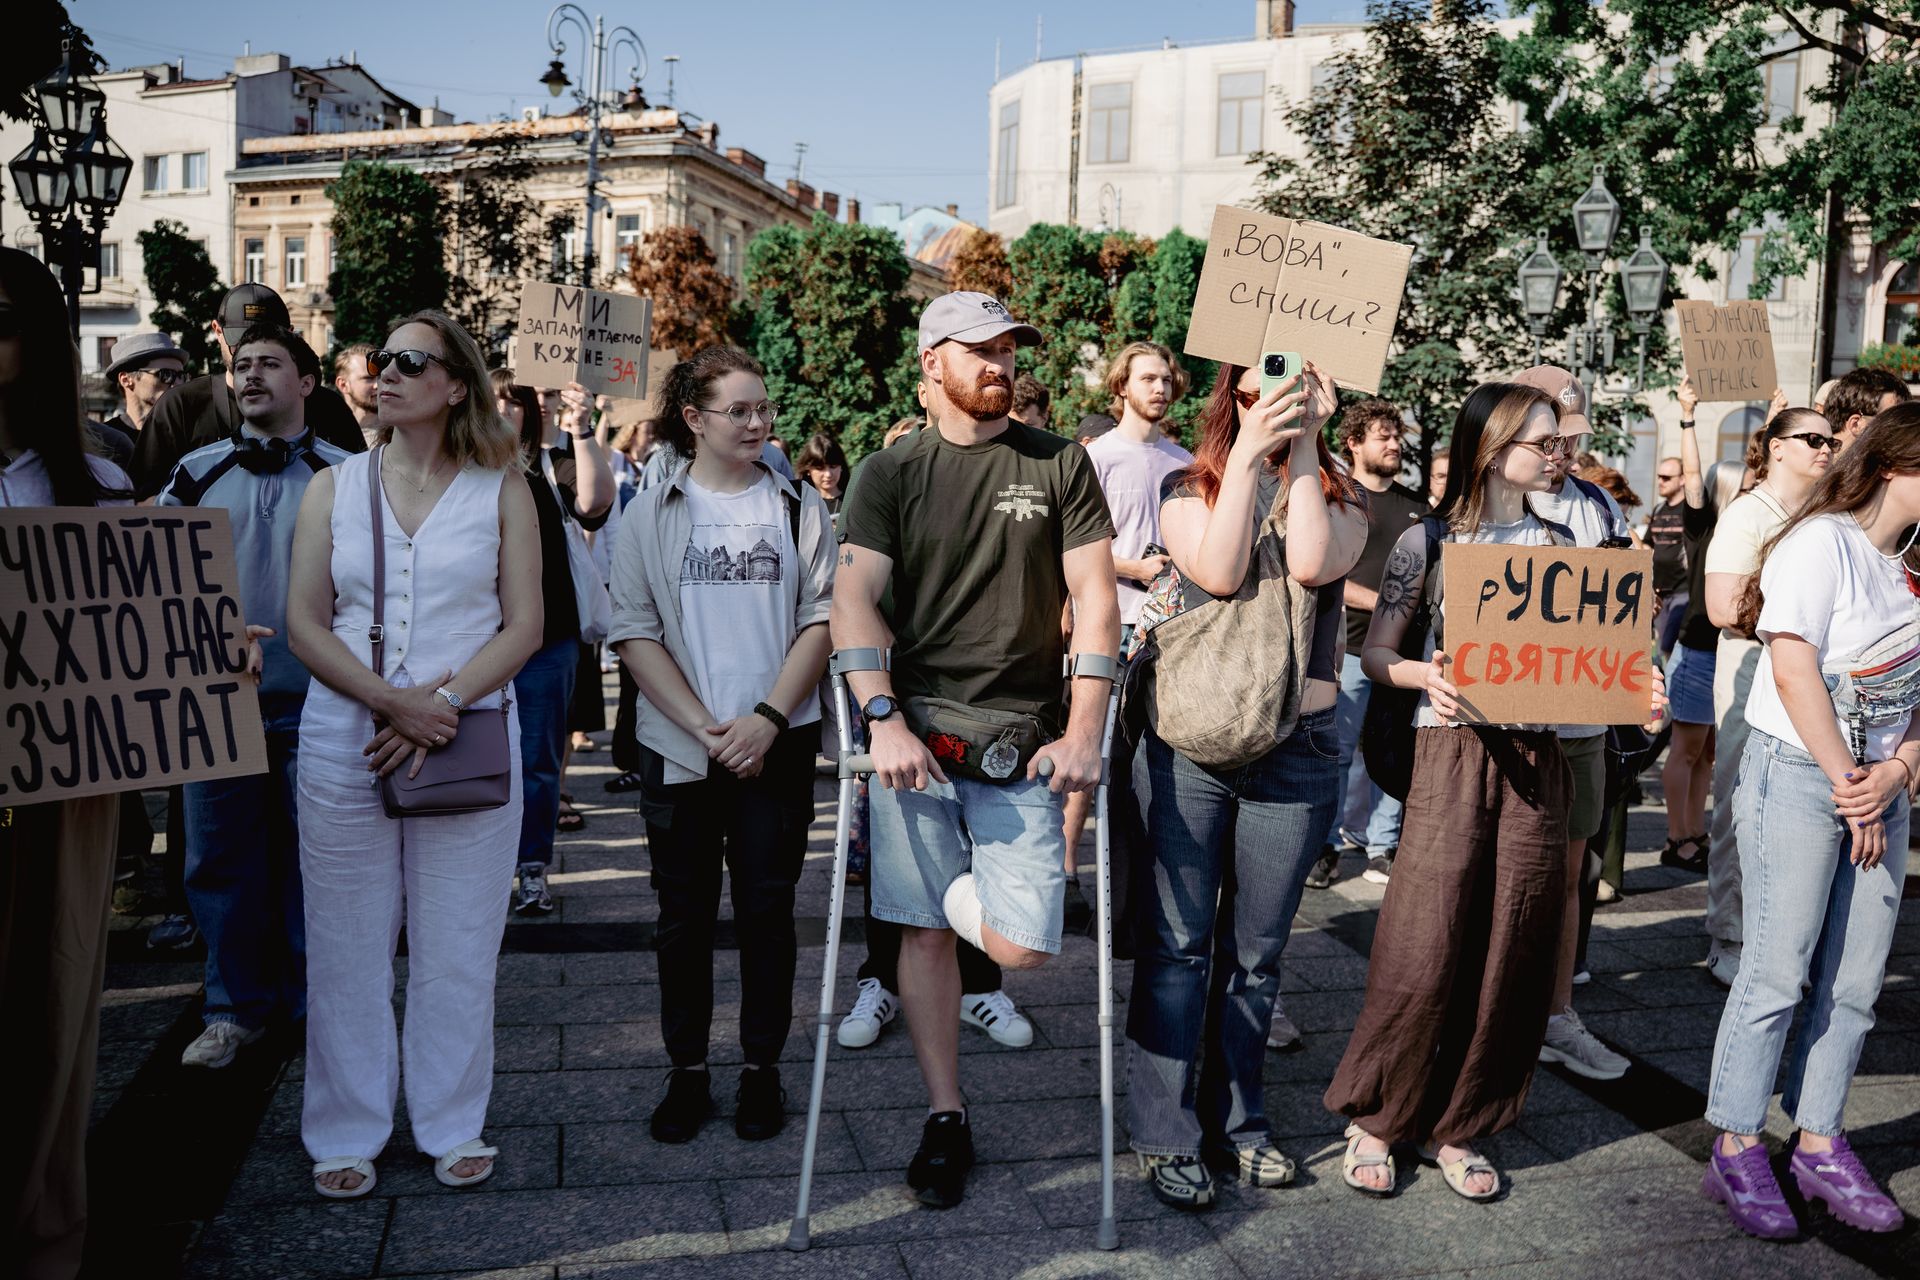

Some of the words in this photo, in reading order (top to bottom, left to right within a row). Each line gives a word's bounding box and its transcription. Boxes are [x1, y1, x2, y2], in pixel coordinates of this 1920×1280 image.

[553, 286, 610, 326] МИ
[1681, 307, 1701, 334] НЕ
[1694, 339, 1730, 363] ТИХ
[1736, 339, 1764, 362] ХТО
[161, 595, 247, 679] ДАЄ
[1452, 641, 1649, 693] СВЯТКУЄ
[0, 681, 240, 795] ЗУЛЬТАТ
